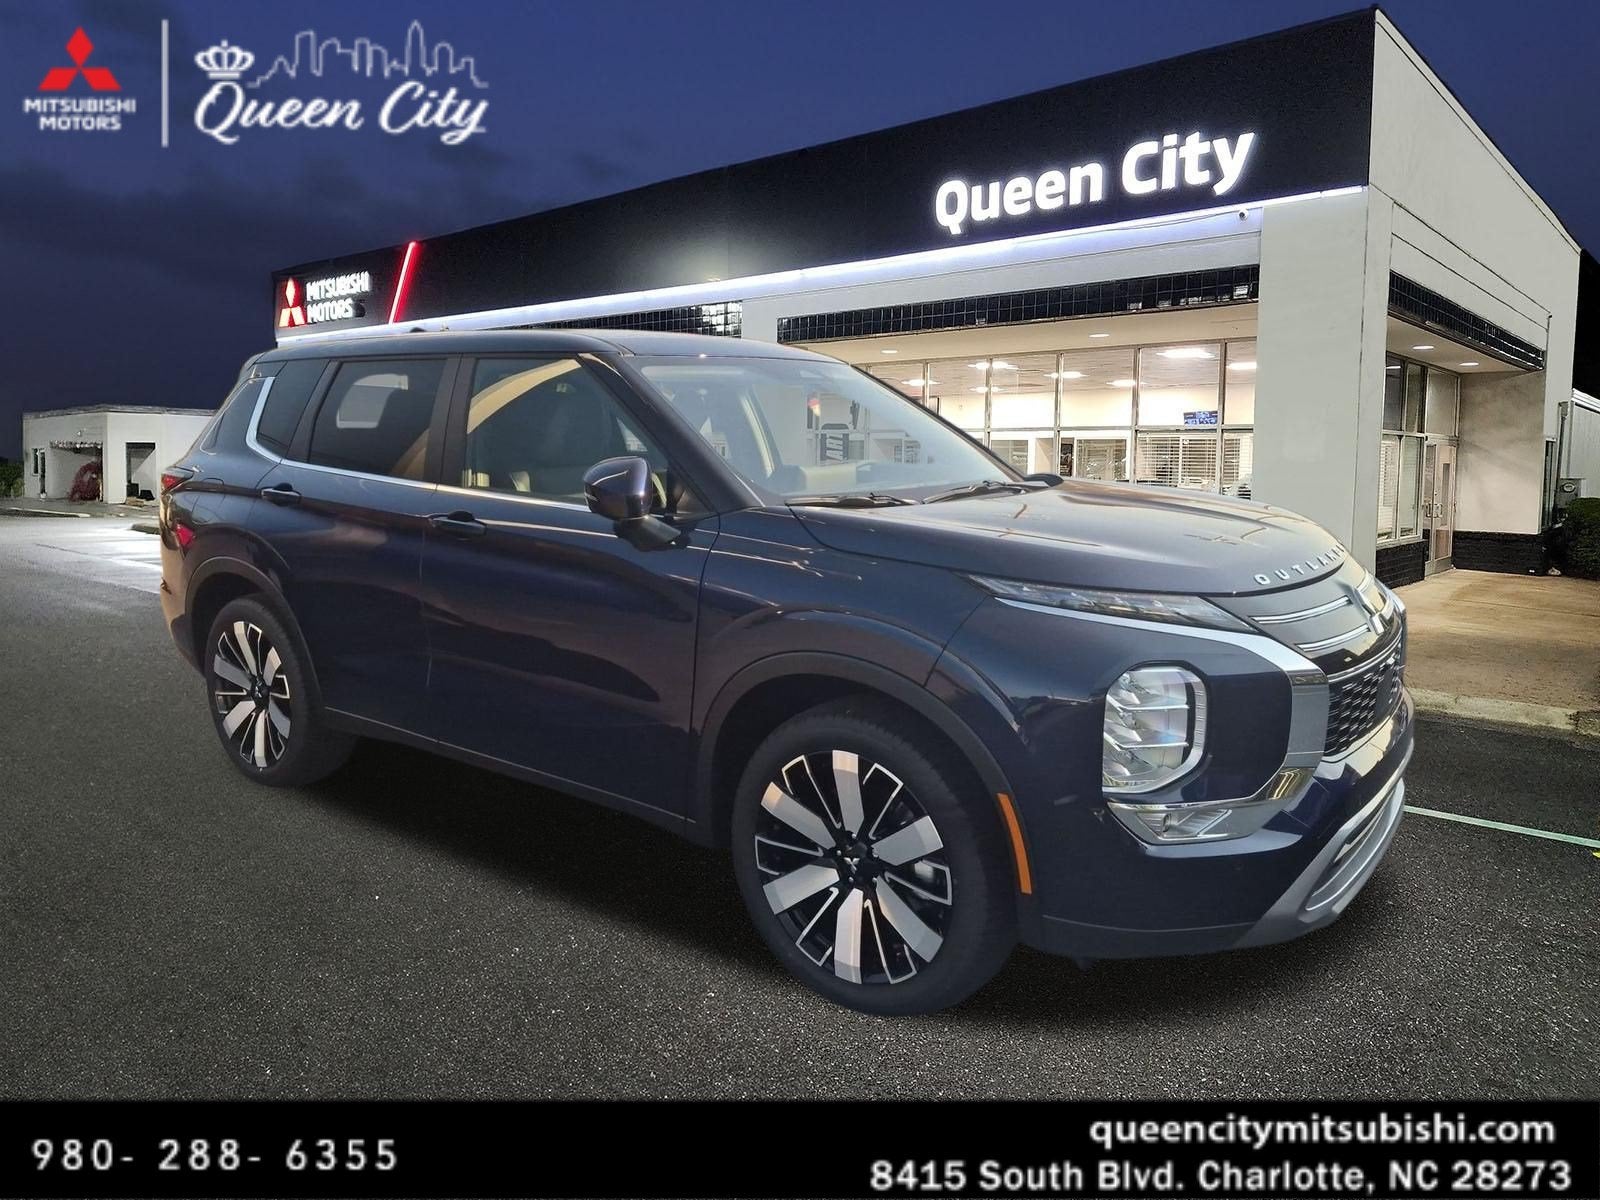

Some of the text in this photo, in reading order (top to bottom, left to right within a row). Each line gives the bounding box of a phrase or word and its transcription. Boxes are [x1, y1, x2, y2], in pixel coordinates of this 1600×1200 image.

[935, 131, 1256, 235] Queen City
[305, 270, 371, 301] MITSUBISHI
[306, 297, 355, 324] MOTORS
